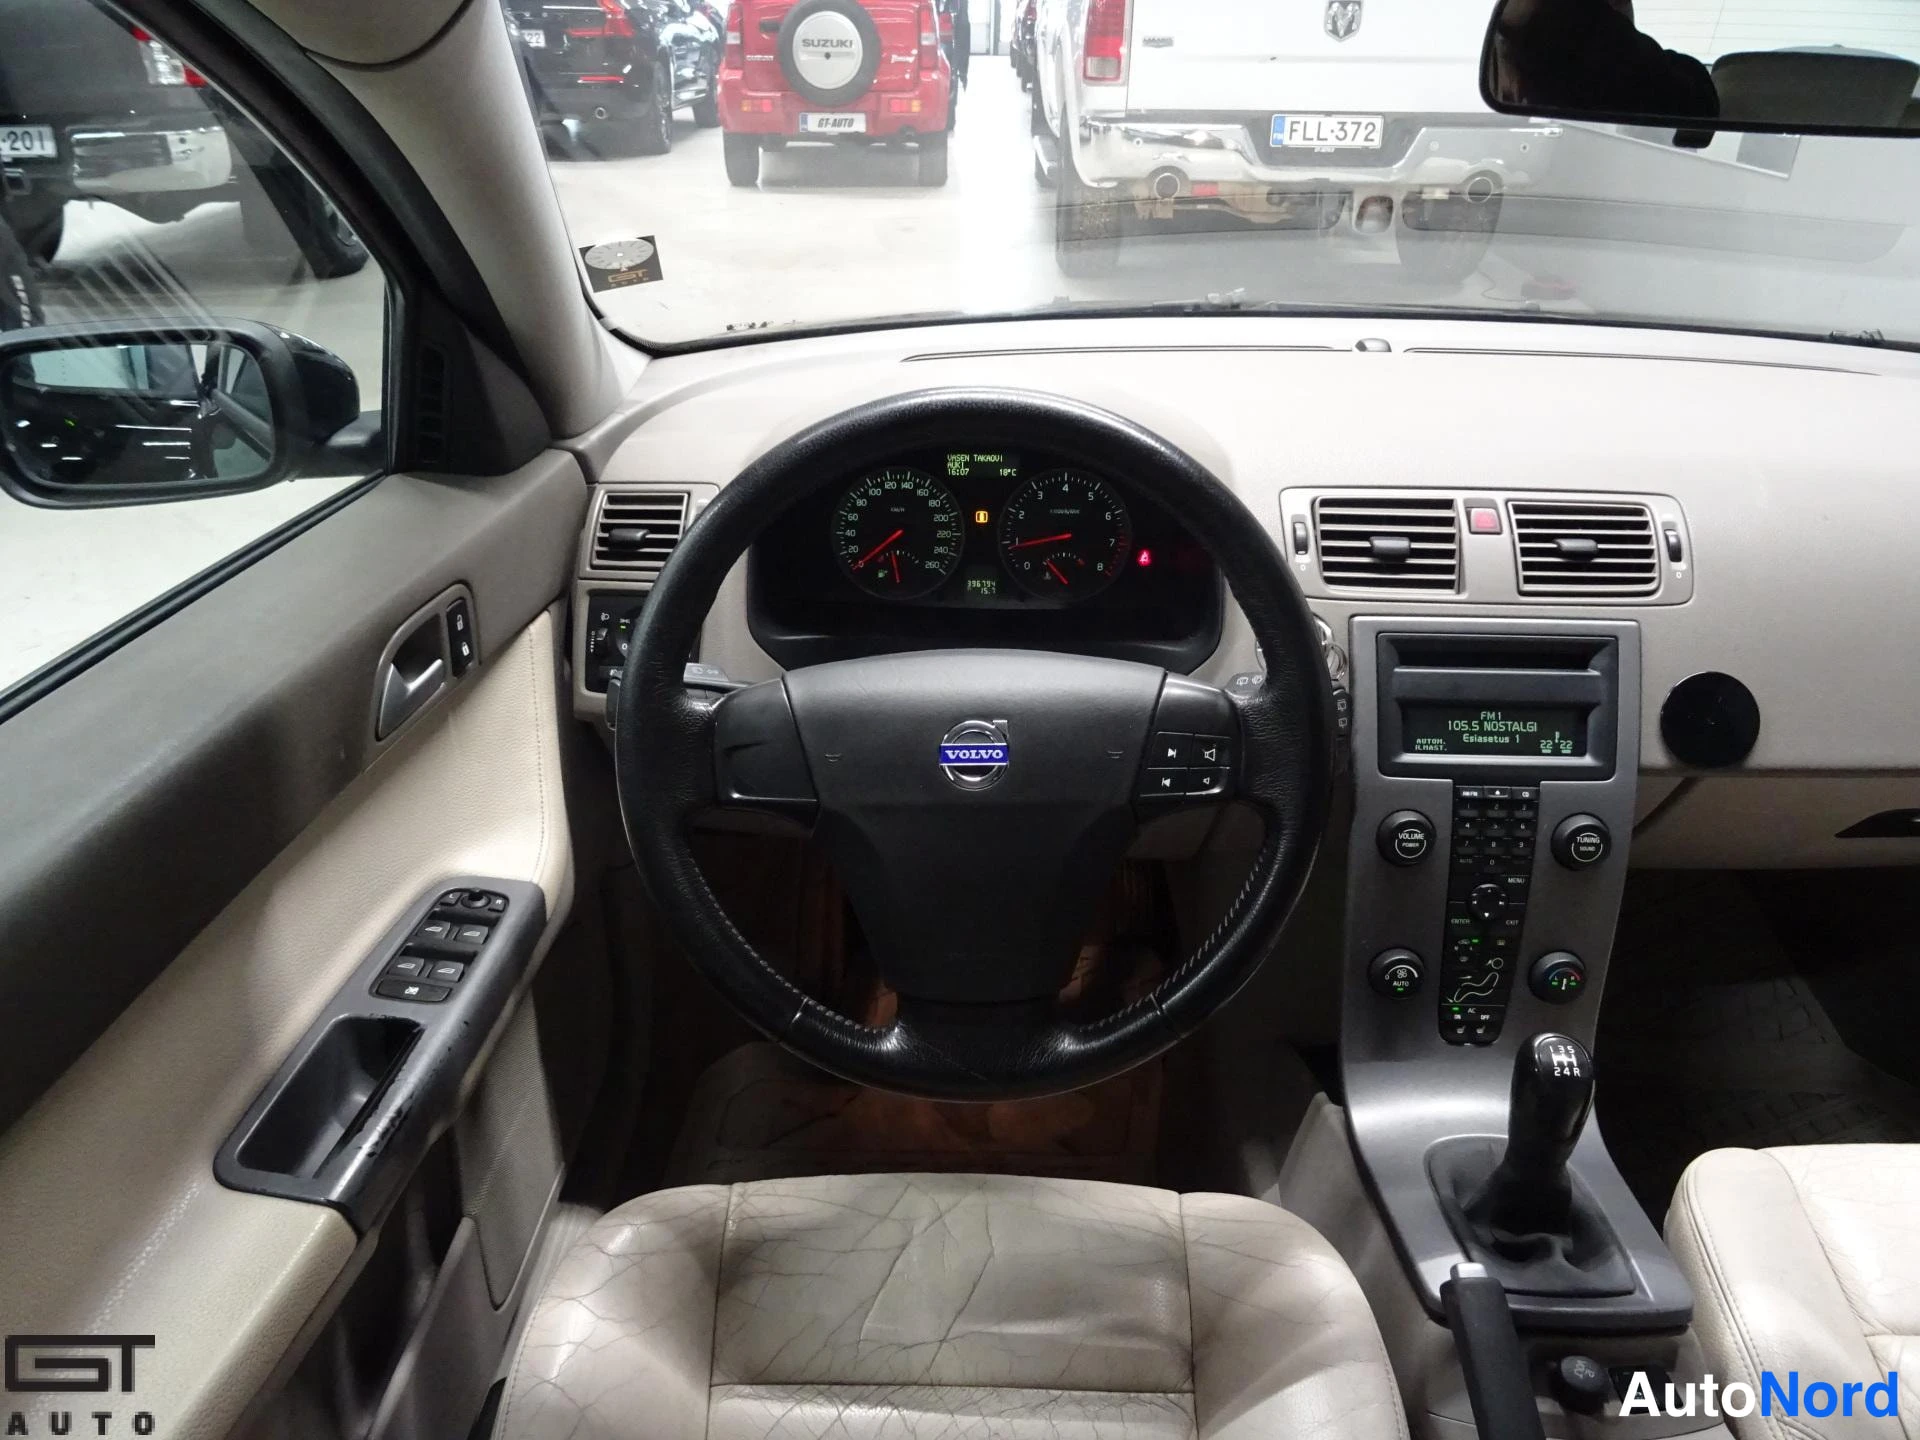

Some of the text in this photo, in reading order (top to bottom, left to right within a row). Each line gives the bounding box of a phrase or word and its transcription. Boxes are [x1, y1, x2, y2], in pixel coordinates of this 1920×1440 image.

[802, 38, 853, 49] SUZUKI
[817, 117, 854, 129] GT-AUTO
[948, 468, 1017, 477] 16:07 18°C
[884, 481, 897, 490] 120
[901, 481, 914, 490] 140
[1062, 483, 1069, 492] 4
[868, 488, 882, 496] 100
[916, 488, 929, 497] 160
[1037, 491, 1044, 500] 3
[1088, 492, 1094, 501] 5
[856, 498, 867, 507] 80
[928, 499, 941, 508] 180
[847, 513, 858, 521] 60
[933, 514, 949, 522] 200
[1018, 511, 1025, 520] 2
[1105, 512, 1112, 521] 6
[845, 529, 856, 537] 40
[936, 530, 952, 538] 220
[1109, 538, 1116, 547] 7
[848, 545, 859, 553] 20
[933, 546, 949, 554] 240
[925, 560, 940, 569] 260
[1023, 562, 1031, 570] 0
[1097, 562, 1104, 571] 8
[1448, 720, 1538, 732] 105.5 NOSTALGI
[1462, 733, 1510, 743] Esiasetus
[1540, 739, 1553, 749] 22
[1559, 740, 1573, 750] 22
[945, 749, 1004, 760] VOLVO
[1398, 832, 1424, 840] VOLUME
[1576, 836, 1600, 844] TUNING
[1553, 1066, 1581, 1078] 2 4 R
